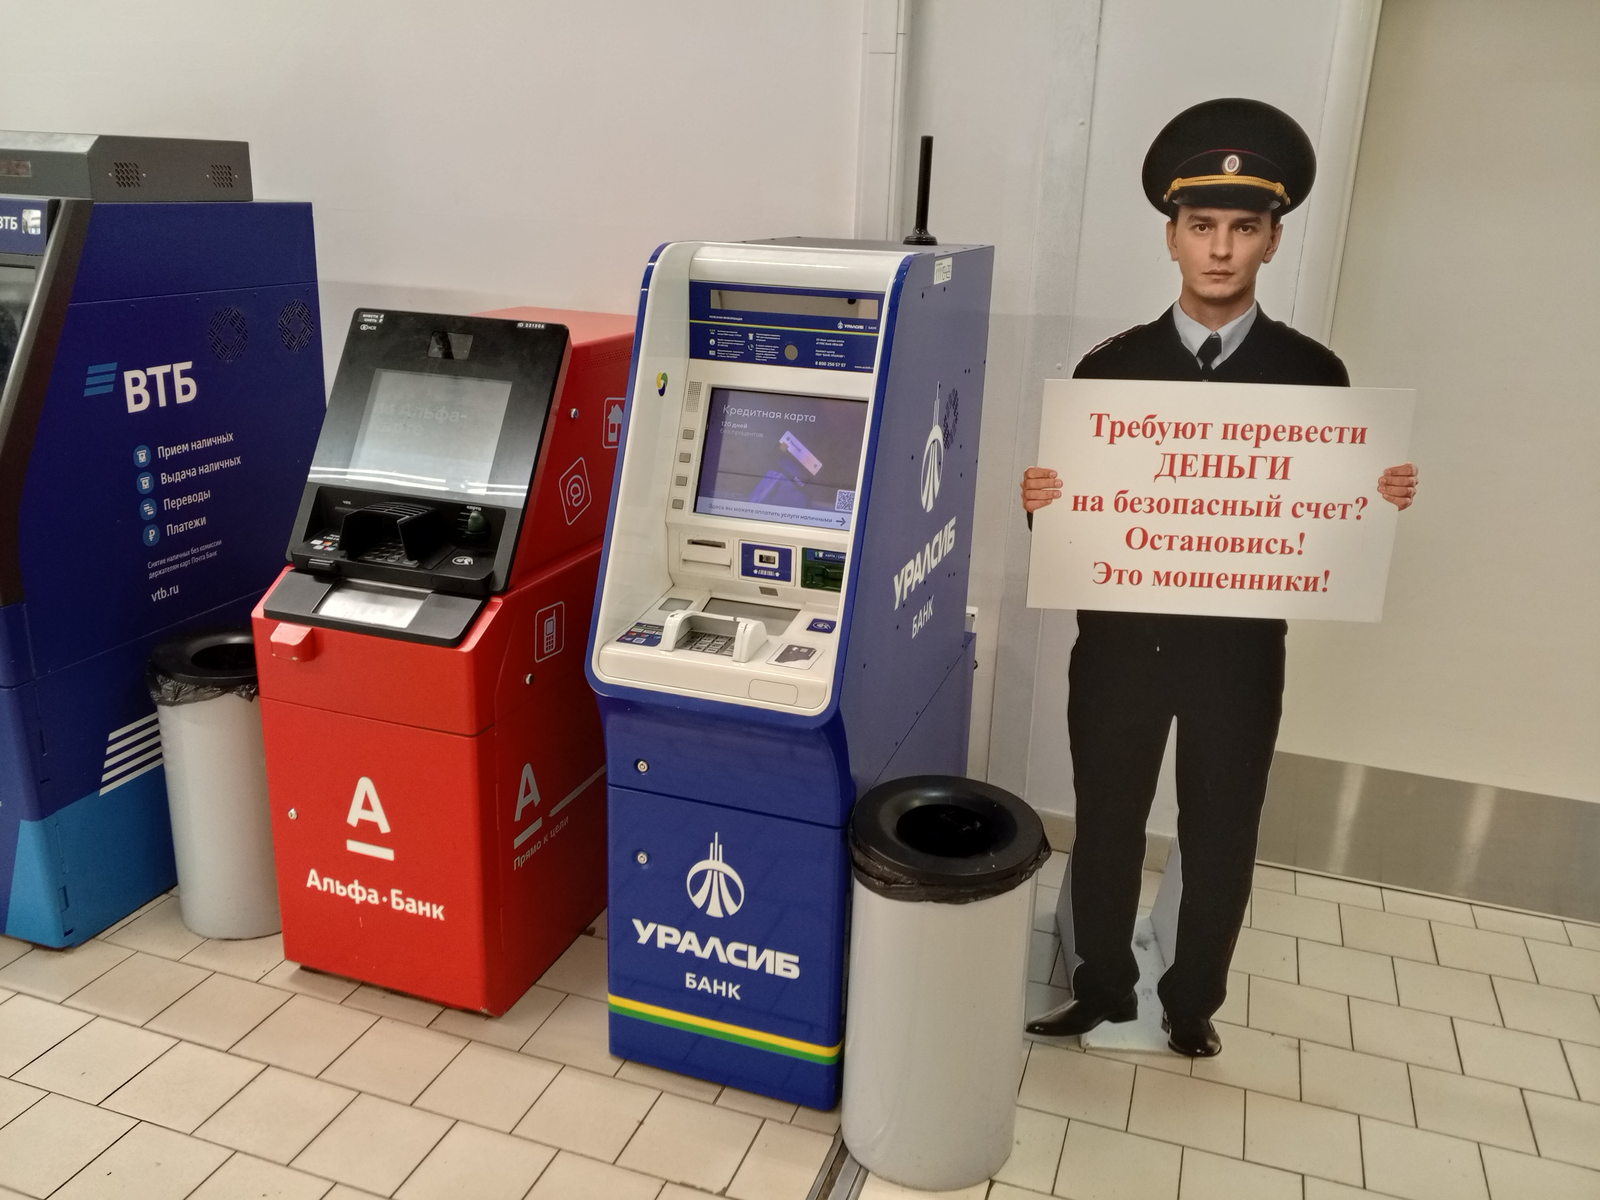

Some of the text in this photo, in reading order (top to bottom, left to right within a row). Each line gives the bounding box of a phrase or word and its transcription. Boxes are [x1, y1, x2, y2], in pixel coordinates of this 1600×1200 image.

[123, 361, 197, 413] ВТБ
[722, 404, 816, 423] Кредитная карта
[1090, 413, 1368, 448] Требуют перевести
[157, 432, 234, 460] Прием наличных
[160, 456, 241, 485] Выдача наличных
[1154, 452, 1294, 483] ДЕНЬГИ
[163, 489, 211, 511] Переводы
[1071, 489, 1369, 520] на безопасный счет?
[166, 516, 207, 536] Платежи
[754, 509, 780, 517] оплатить
[800, 514, 833, 523] наличными
[147, 540, 222, 569] Снятие наличных без комиссии
[1125, 526, 1306, 556] Остановись!
[148, 550, 218, 580] держателям карт Почта Банк
[893, 516, 957, 611] УРАЛСИБ
[1092, 561, 1330, 593] Это мошенники!
[151, 585, 179, 602] vtb.ru
[911, 595, 935, 640] БАНК
[513, 815, 569, 870] Прямо к цели
[632, 918, 800, 980] УРАЛСИБ
[685, 972, 741, 1001] БАНК
